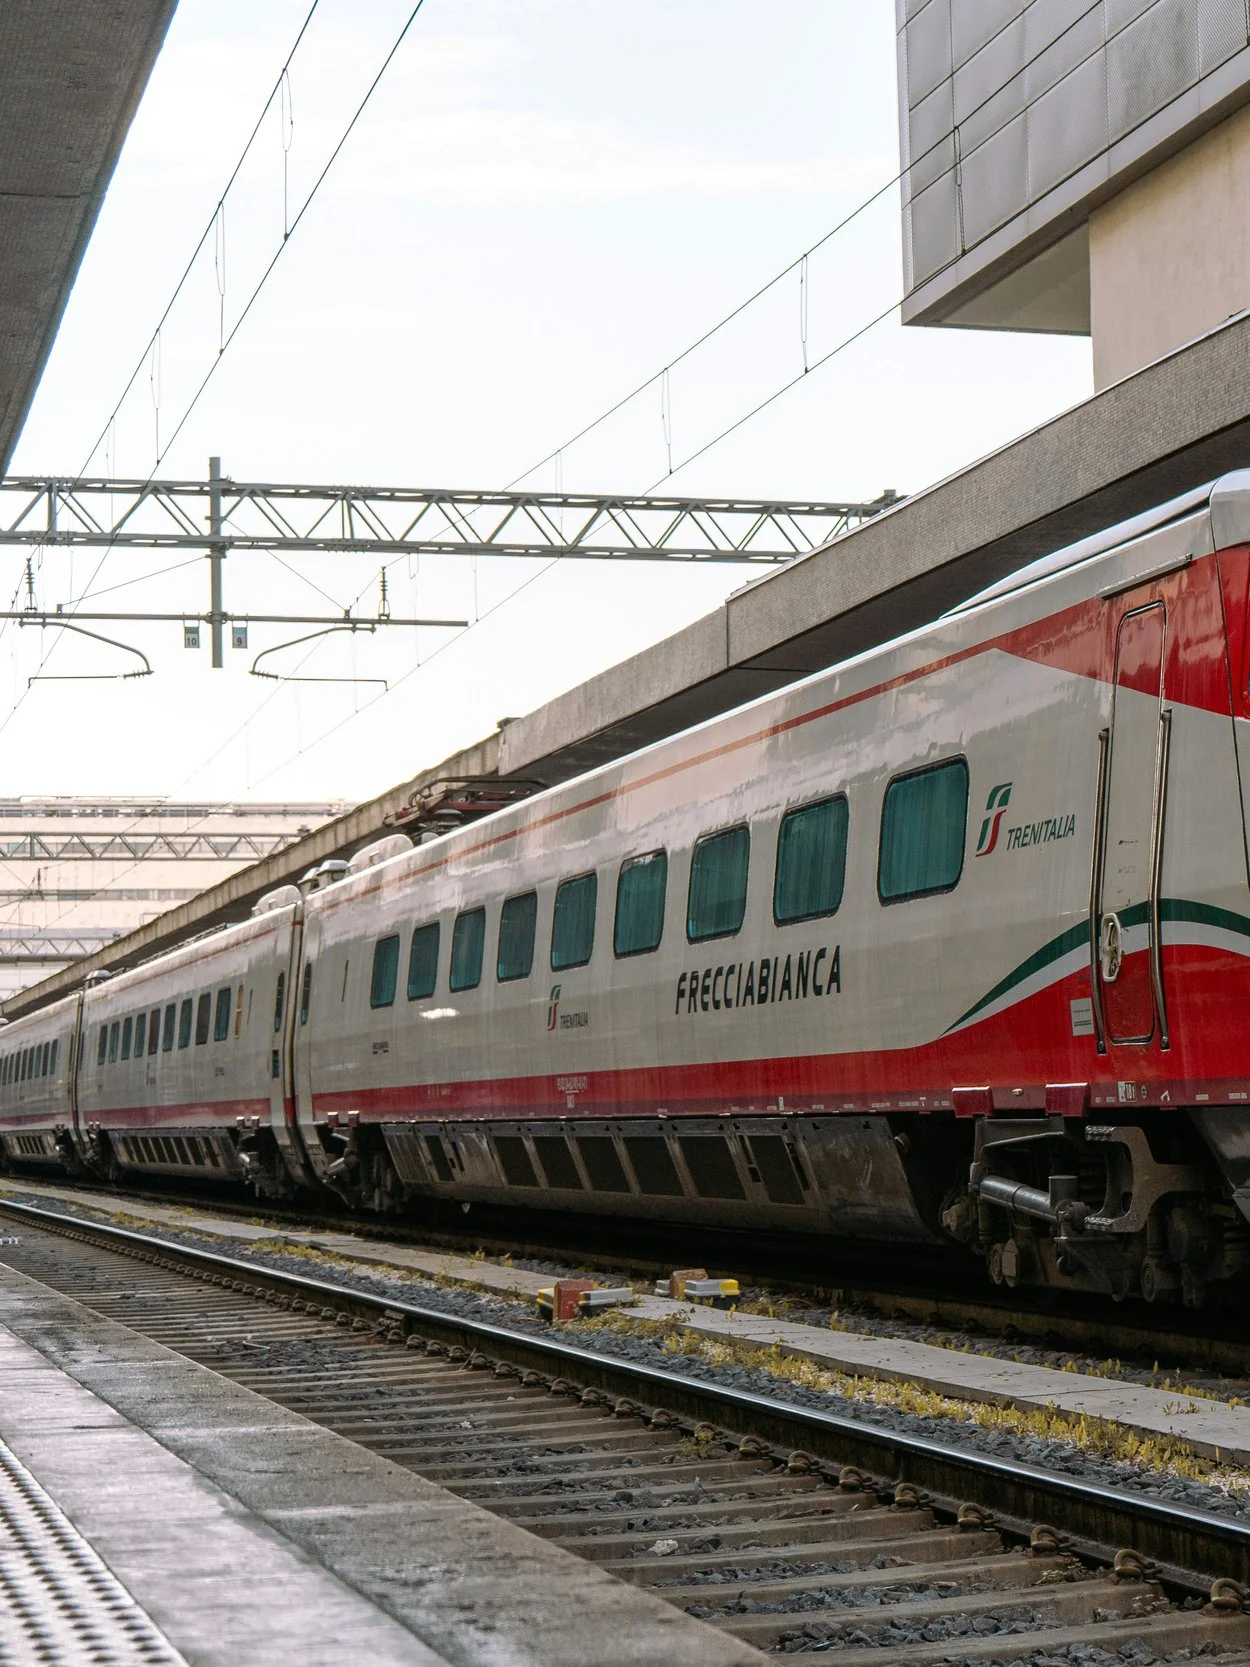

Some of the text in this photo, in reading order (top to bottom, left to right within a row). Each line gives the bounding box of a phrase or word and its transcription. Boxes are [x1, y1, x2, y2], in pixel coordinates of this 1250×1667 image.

[187, 637, 197, 646] 10
[236, 637, 243, 646] 9
[1006, 813, 1076, 851] TRENITALIA
[675, 944, 842, 1015] FRECCIABIANCA
[560, 1012, 589, 1029] TRENITALIA
